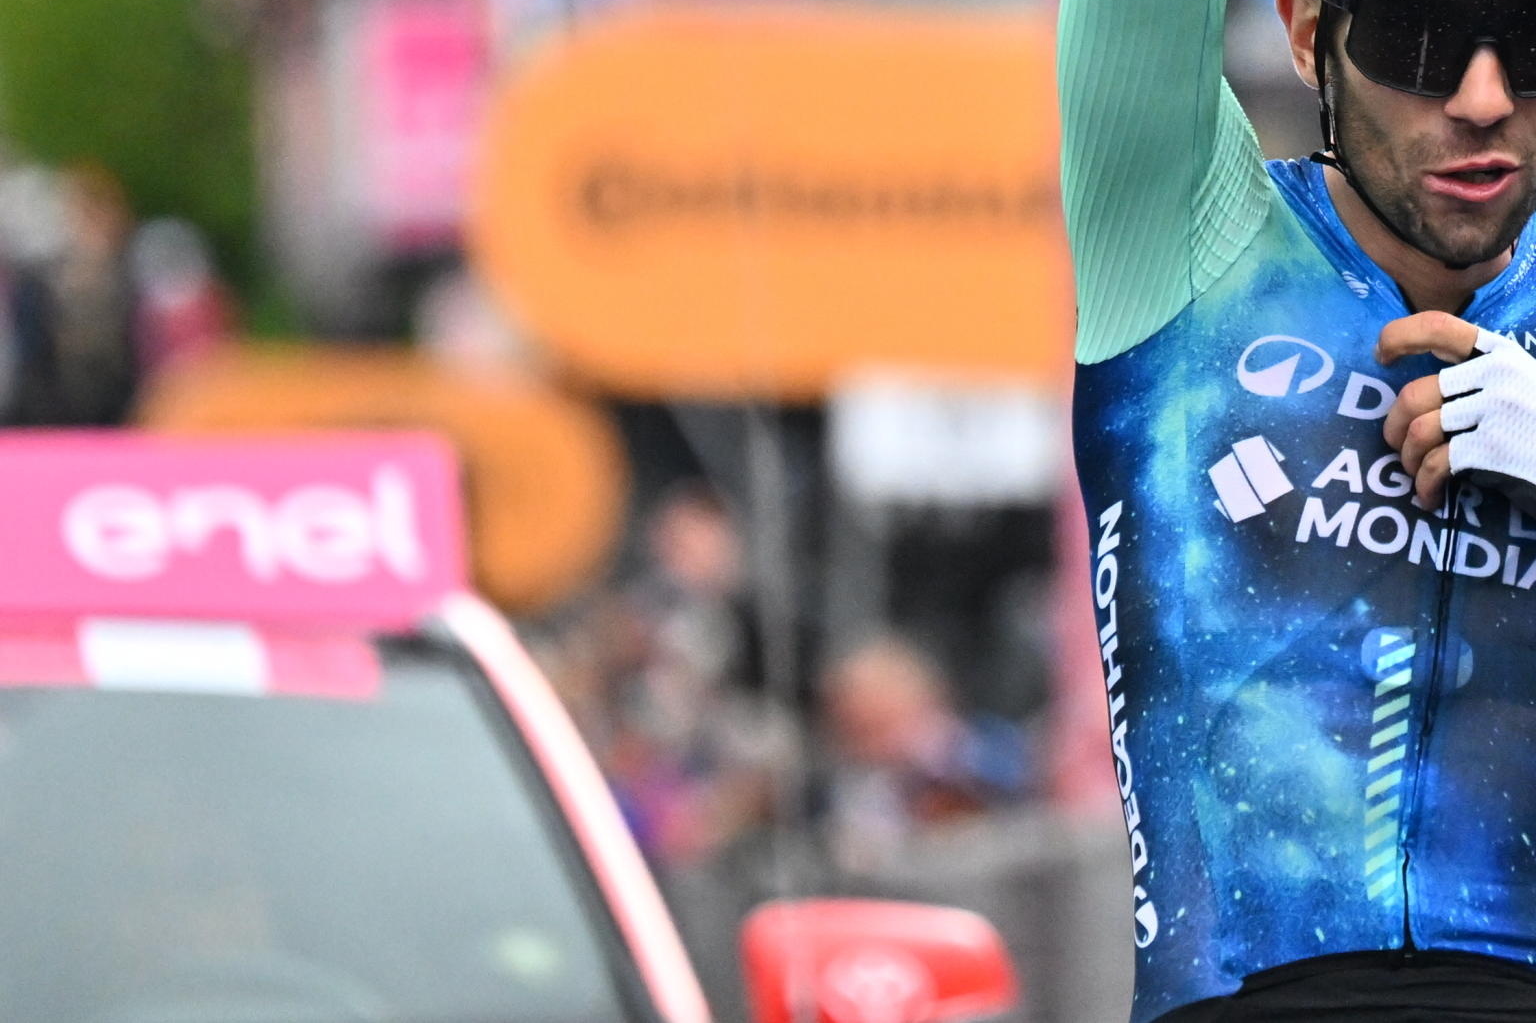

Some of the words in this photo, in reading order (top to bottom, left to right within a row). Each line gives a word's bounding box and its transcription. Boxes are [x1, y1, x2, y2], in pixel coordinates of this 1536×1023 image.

[61, 463, 424, 583] enel
[1311, 447, 1483, 528] AGR
[1095, 499, 1149, 877] DECATHLON
